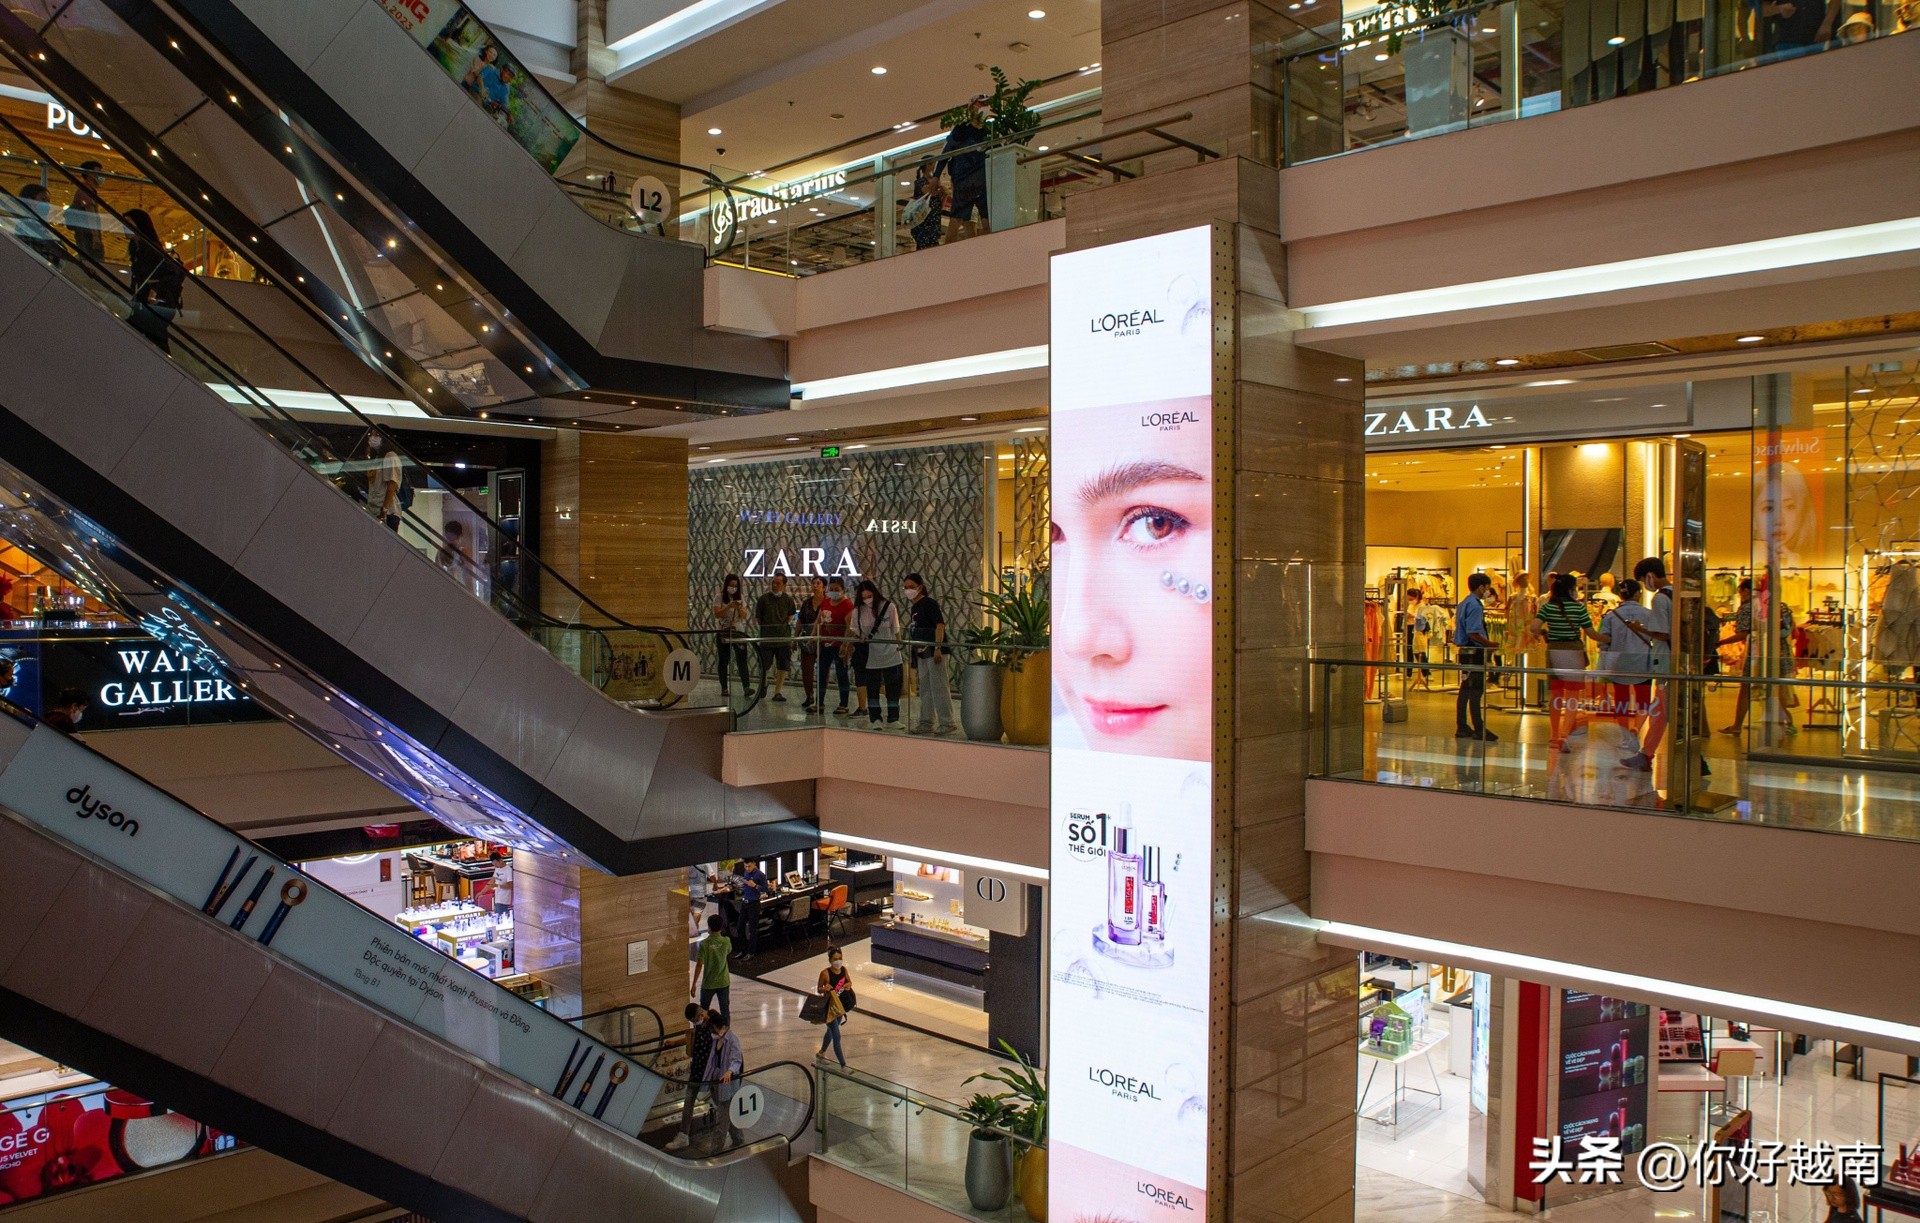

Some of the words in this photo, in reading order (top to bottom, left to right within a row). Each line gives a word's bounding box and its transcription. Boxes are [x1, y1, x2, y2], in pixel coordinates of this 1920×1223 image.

[47, 102, 102, 140] PU
[639, 188, 662, 213] L2
[1091, 308, 1165, 333] L'ORÉAL
[1114, 328, 1141, 338] PARIS
[1141, 411, 1200, 427] L'ORÉAL
[1159, 424, 1181, 432] PARIS
[1364, 404, 1493, 436] ZARA
[743, 546, 863, 578] ZARA
[672, 660, 692, 682] M
[100, 678, 250, 707] GALLER
[66, 784, 140, 838] dyson
[1069, 812, 1091, 821] SERUM
[1068, 819, 1097, 844] SỐ
[1068, 842, 1086, 854] THẾ
[1087, 846, 1107, 857] GIỚI
[362, 950, 381, 967] Độc
[381, 961, 407, 982] quyền
[408, 973, 419, 988] tại
[370, 977, 381, 988] B1
[370, 936, 395, 956] Phiên
[394, 950, 411, 967] bản
[412, 960, 429, 975] mới
[429, 968, 449, 986] nhất
[448, 979, 468, 997] Xanh
[468, 990, 499, 1015] Prussian
[499, 1008, 509, 1020] và
[509, 1013, 532, 1034] Đồng.
[1088, 1066, 1162, 1101] L'ORÉAL
[1111, 1088, 1138, 1103] PARIS
[738, 1092, 757, 1117] L1
[9, 1147, 38, 1161] VELVET
[1137, 1181, 1194, 1211] L'ORÉAL
[1154, 1199, 1176, 1211] PARIS
